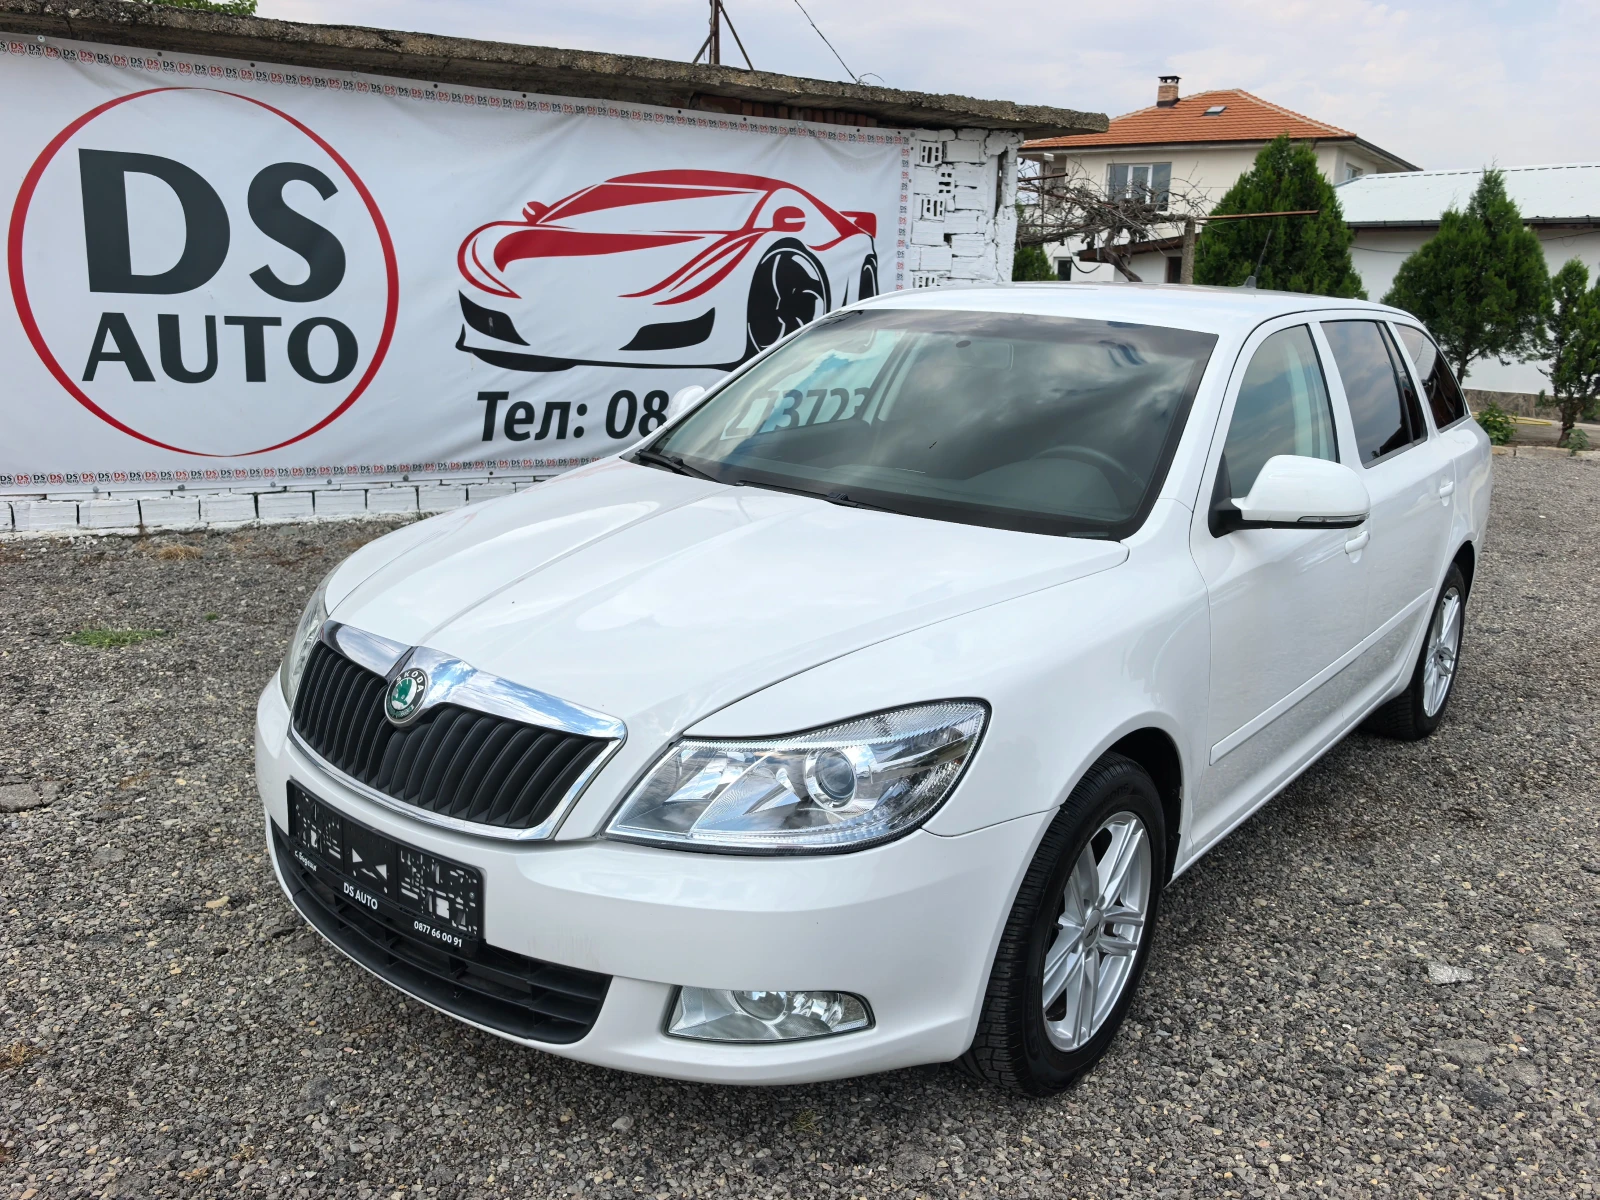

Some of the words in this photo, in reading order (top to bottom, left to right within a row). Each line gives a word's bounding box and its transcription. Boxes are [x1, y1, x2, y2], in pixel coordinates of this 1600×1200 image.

[78, 148, 347, 303] DS
[82, 312, 359, 384] AUTO
[476, 391, 588, 441] Тел:
[343, 882, 354, 897] DS
[355, 889, 378, 910] AUTO
[413, 920, 431, 935] 0877
[431, 928, 441, 939] 66
[441, 932, 452, 943] 00
[453, 937, 462, 948] 91
